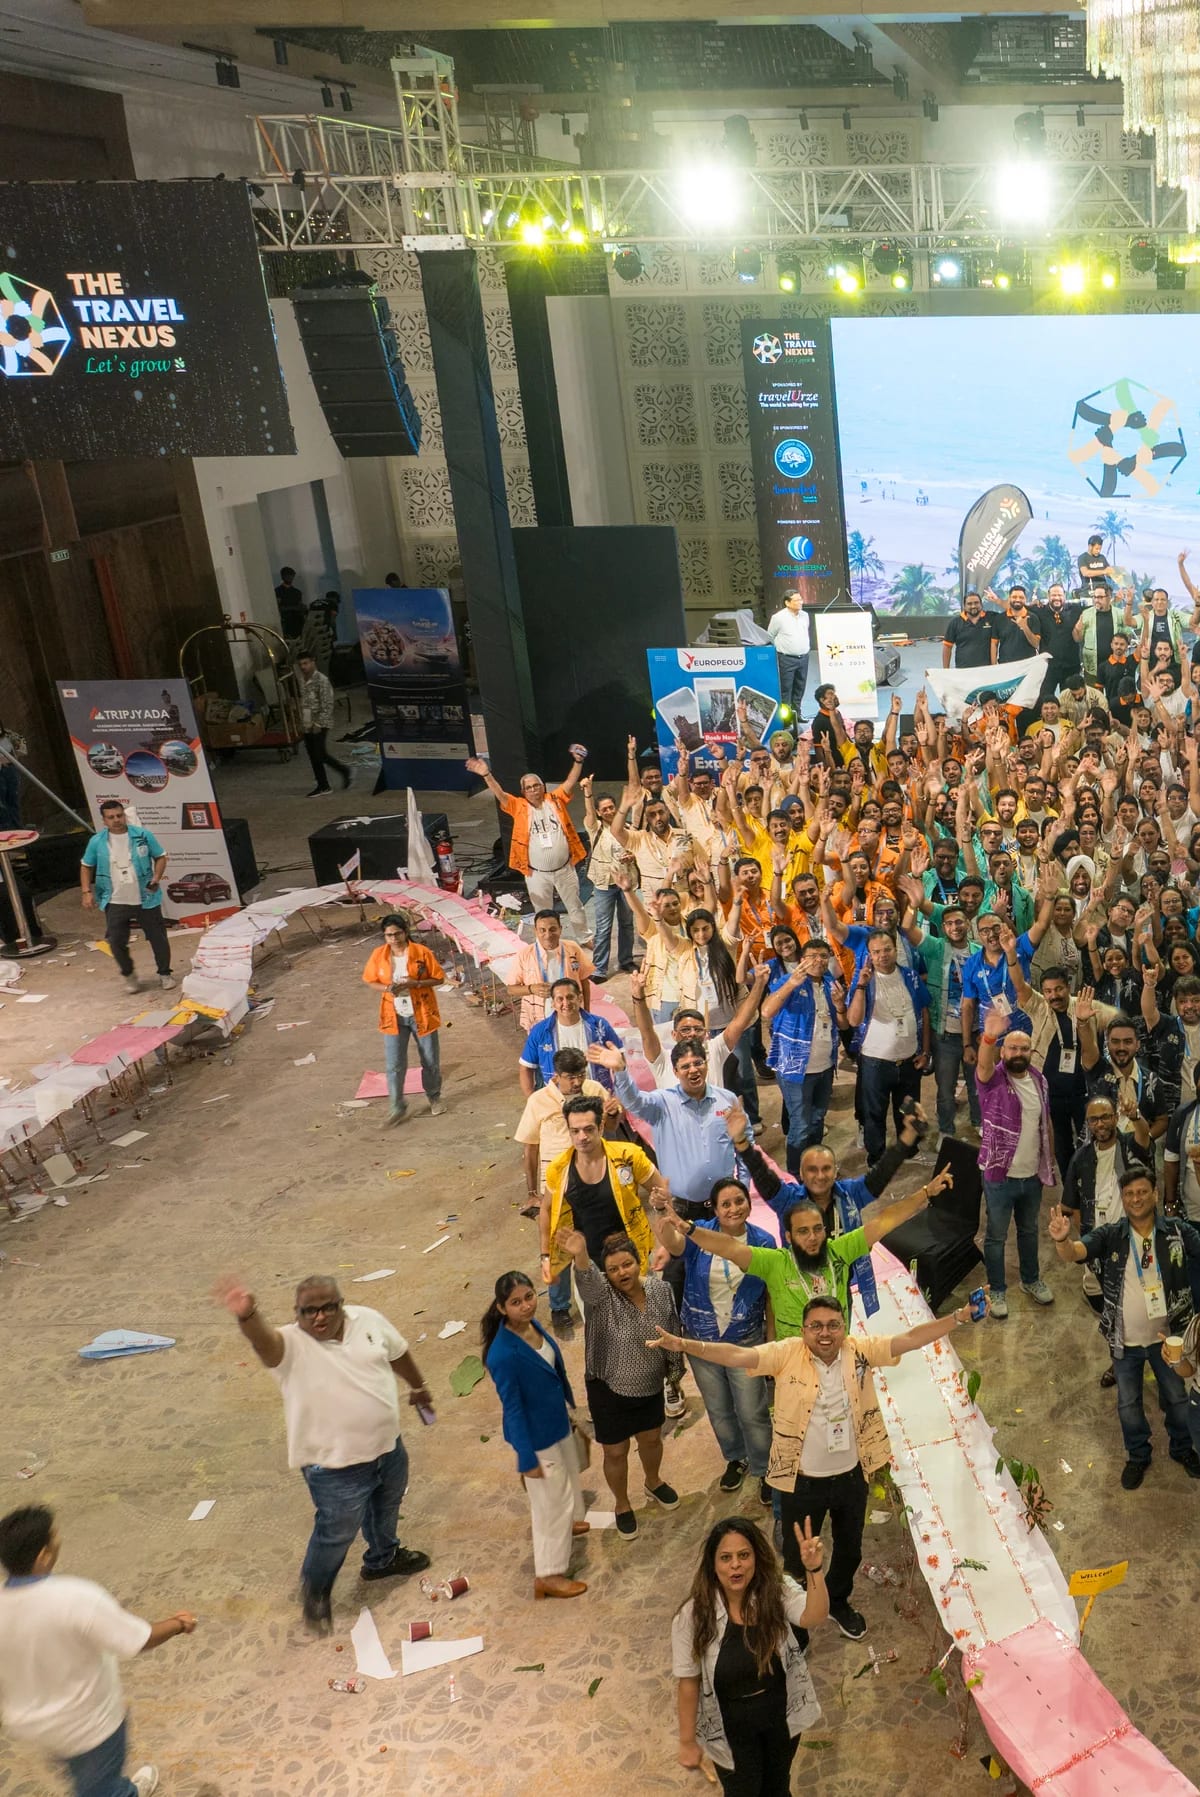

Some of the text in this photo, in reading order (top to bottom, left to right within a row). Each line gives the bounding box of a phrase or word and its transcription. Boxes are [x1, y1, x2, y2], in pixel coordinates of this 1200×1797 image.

[66, 272, 125, 296] THE
[73, 298, 185, 323] TRAVEL
[80, 325, 177, 350] NEXUS
[784, 340, 817, 348] TRAVEL
[785, 348, 814, 356] NEXUS
[85, 354, 172, 379] Let's grow
[758, 389, 819, 401] travelUrze
[966, 517, 1005, 573] PARAKRAM
[694, 659, 745, 667] EUROPEOUS
[104, 709, 170, 720] TRIPJYADA
